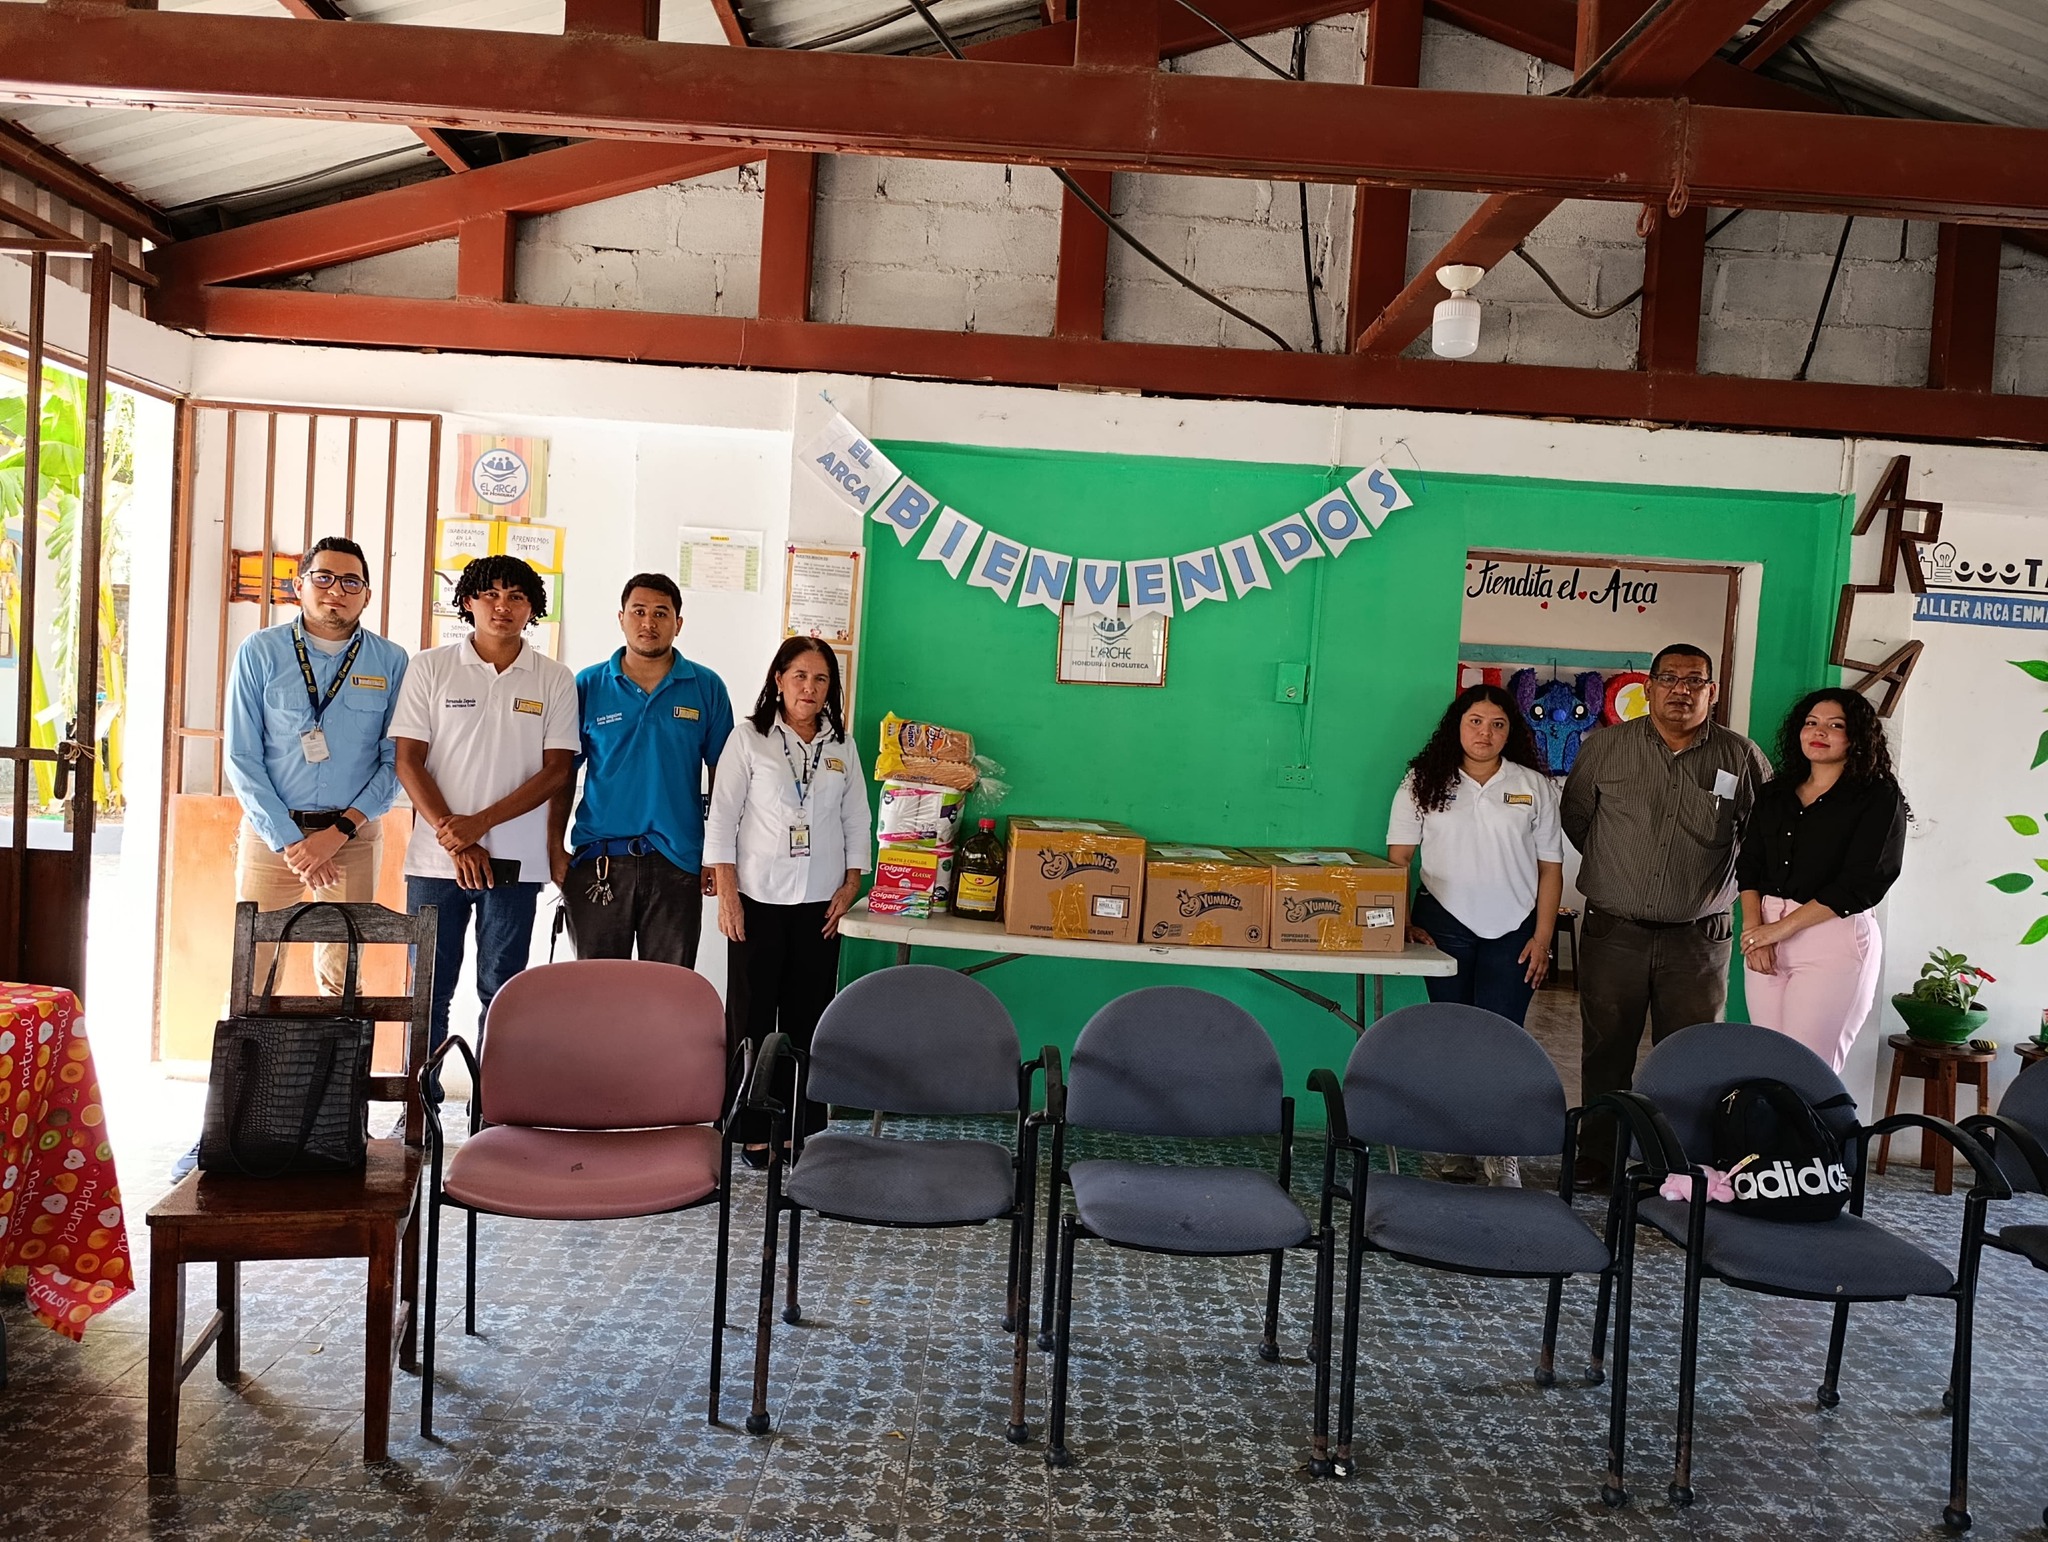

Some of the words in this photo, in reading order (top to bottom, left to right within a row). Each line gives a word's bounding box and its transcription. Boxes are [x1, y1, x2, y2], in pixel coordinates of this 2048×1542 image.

[847, 439, 870, 470] EL
[816, 451, 872, 506] ARCA
[480, 483, 491, 492] EL
[493, 484, 517, 494] ARCA
[512, 534, 550, 545] APRENDEMOS
[885, 469, 1398, 606] BIENVENIDOS
[516, 543, 540, 551] JUNTOS
[1466, 560, 1553, 598] Tiendita
[1556, 568, 1580, 601] el
[1589, 568, 1658, 613] Arca
[1914, 597, 1971, 618] TALLER
[1972, 602, 2009, 621] ARCA
[2012, 604, 2048, 624] ENM
[1090, 646, 1132, 660] L'ARCHE
[1111, 661, 1149, 669] CHOLUTECA
[879, 863, 912, 873] Colgate
[871, 890, 900, 900] Colgate
[870, 901, 902, 911] Colgate
[19, 1014, 35, 1088] natural
[57, 1180, 98, 1244] natural
